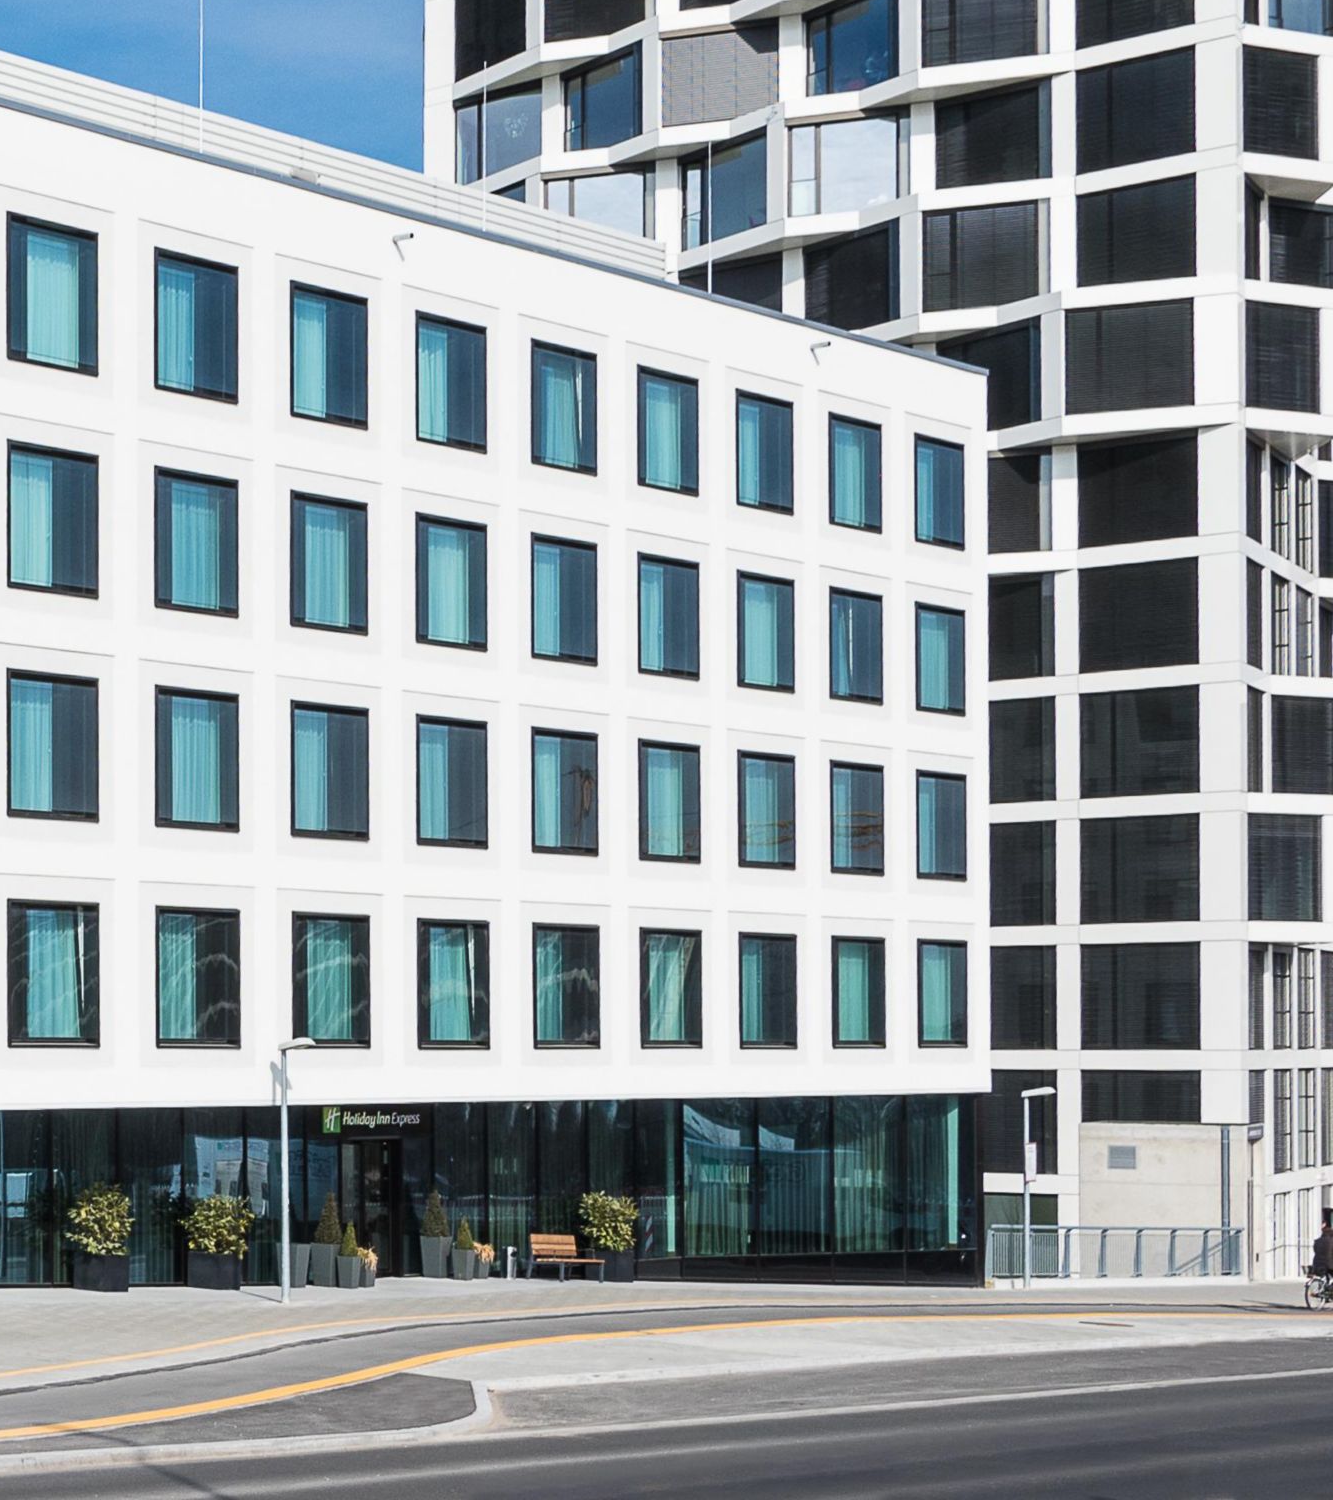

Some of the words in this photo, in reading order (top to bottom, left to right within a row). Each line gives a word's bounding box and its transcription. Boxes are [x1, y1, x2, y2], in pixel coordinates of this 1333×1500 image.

[342, 1111, 376, 1128] Holiday
[376, 1110, 390, 1125] Inn
[391, 1112, 420, 1128] Express
